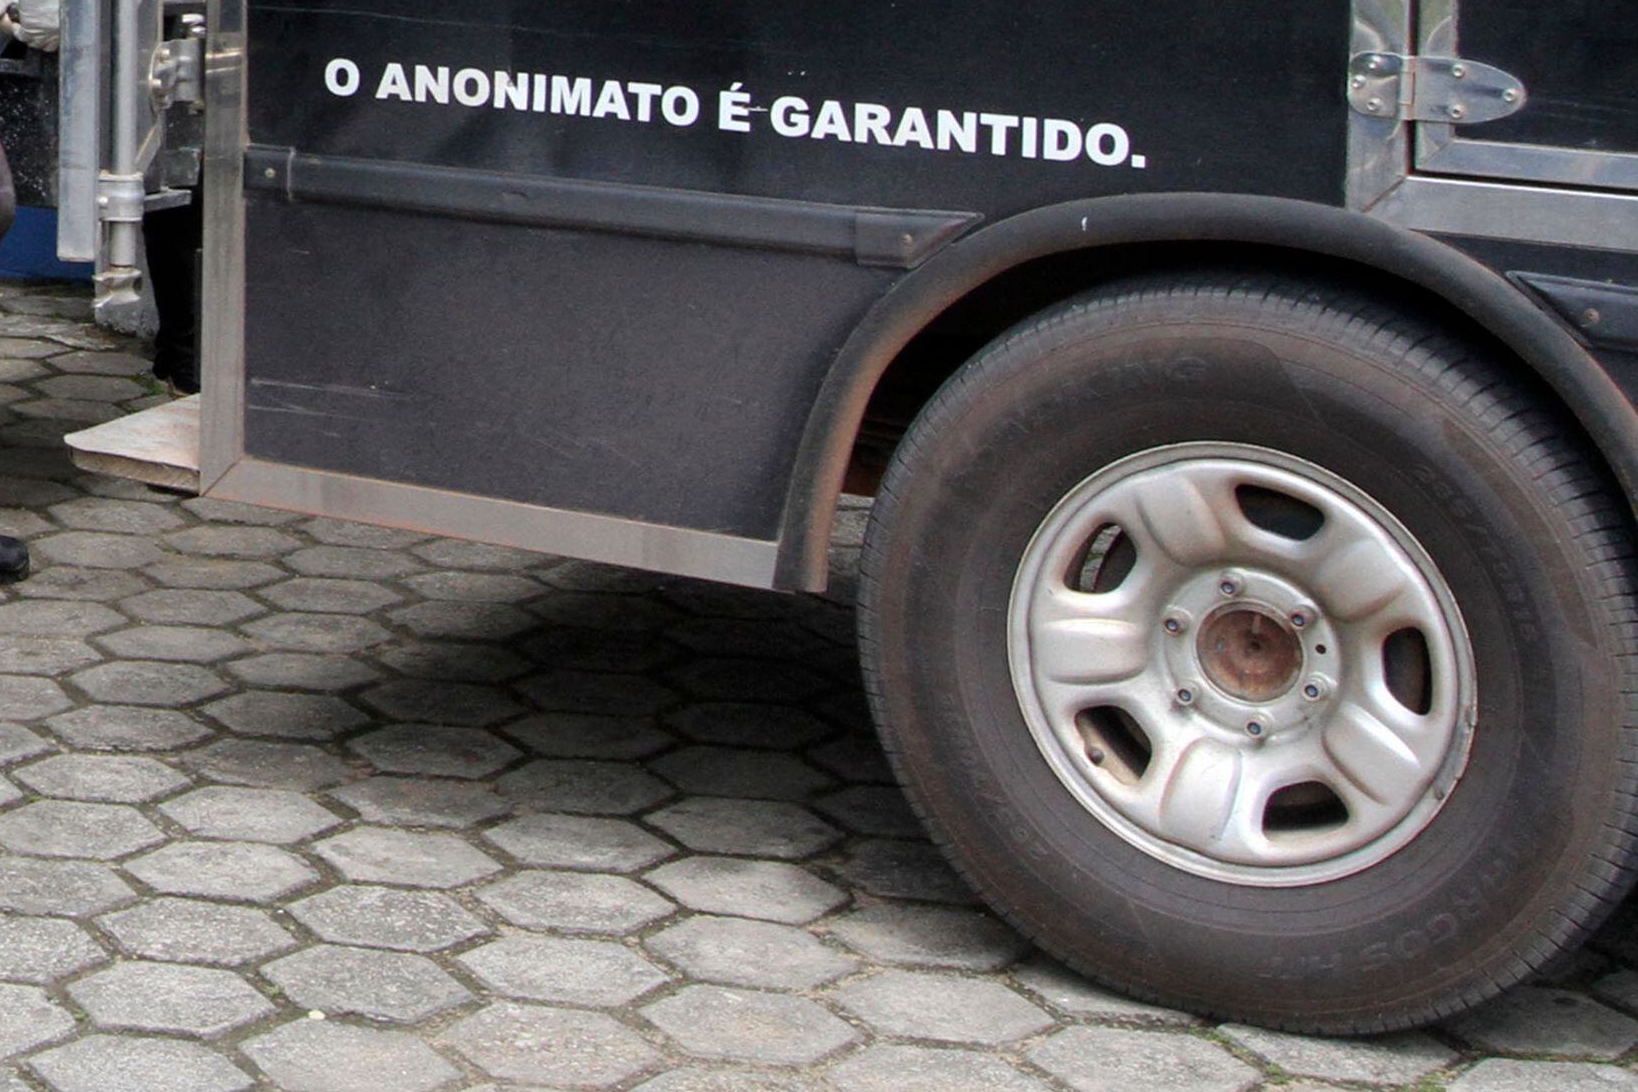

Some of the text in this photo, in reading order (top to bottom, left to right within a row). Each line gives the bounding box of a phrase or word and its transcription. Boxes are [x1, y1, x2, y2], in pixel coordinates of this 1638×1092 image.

[325, 59, 1145, 168] O ANONIMATO É GARANTIDO.
